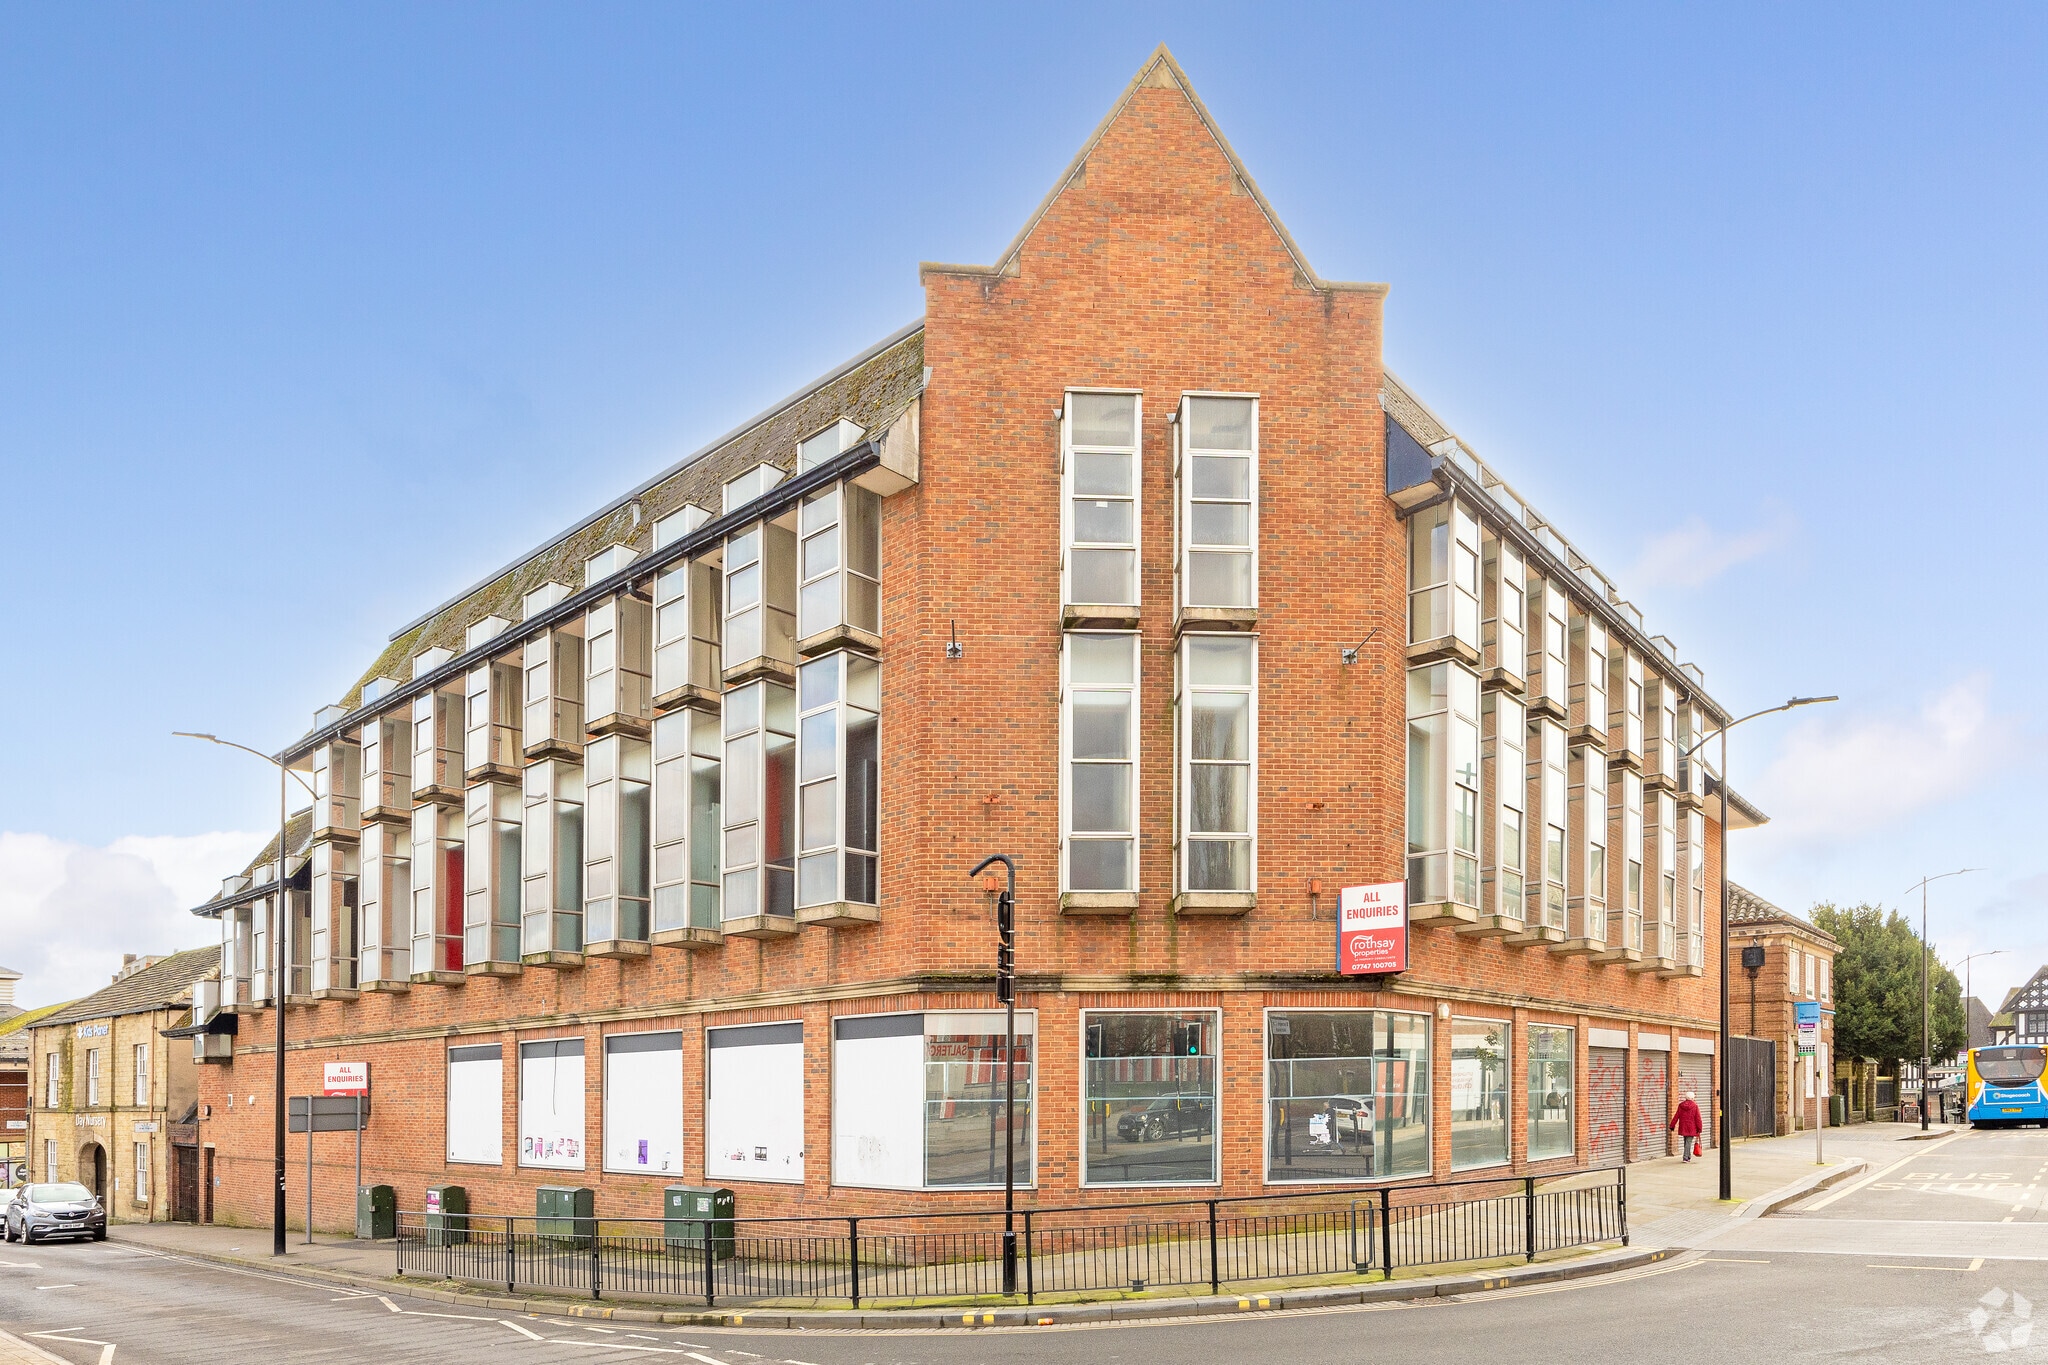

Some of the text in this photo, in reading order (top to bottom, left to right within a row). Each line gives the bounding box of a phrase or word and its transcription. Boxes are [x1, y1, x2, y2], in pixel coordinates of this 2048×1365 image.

[1363, 892, 1380, 902] ALL
[1347, 905, 1398, 919] ENQUIRIES
[1354, 936, 1395, 950] rothsay
[1354, 949, 1389, 958] properties
[83, 1024, 109, 1037] Kids Planet
[76, 1115, 106, 1128] Day Nursery
[1902, 1172, 2014, 1180] BUS
[1866, 1182, 2023, 1191] STOP
